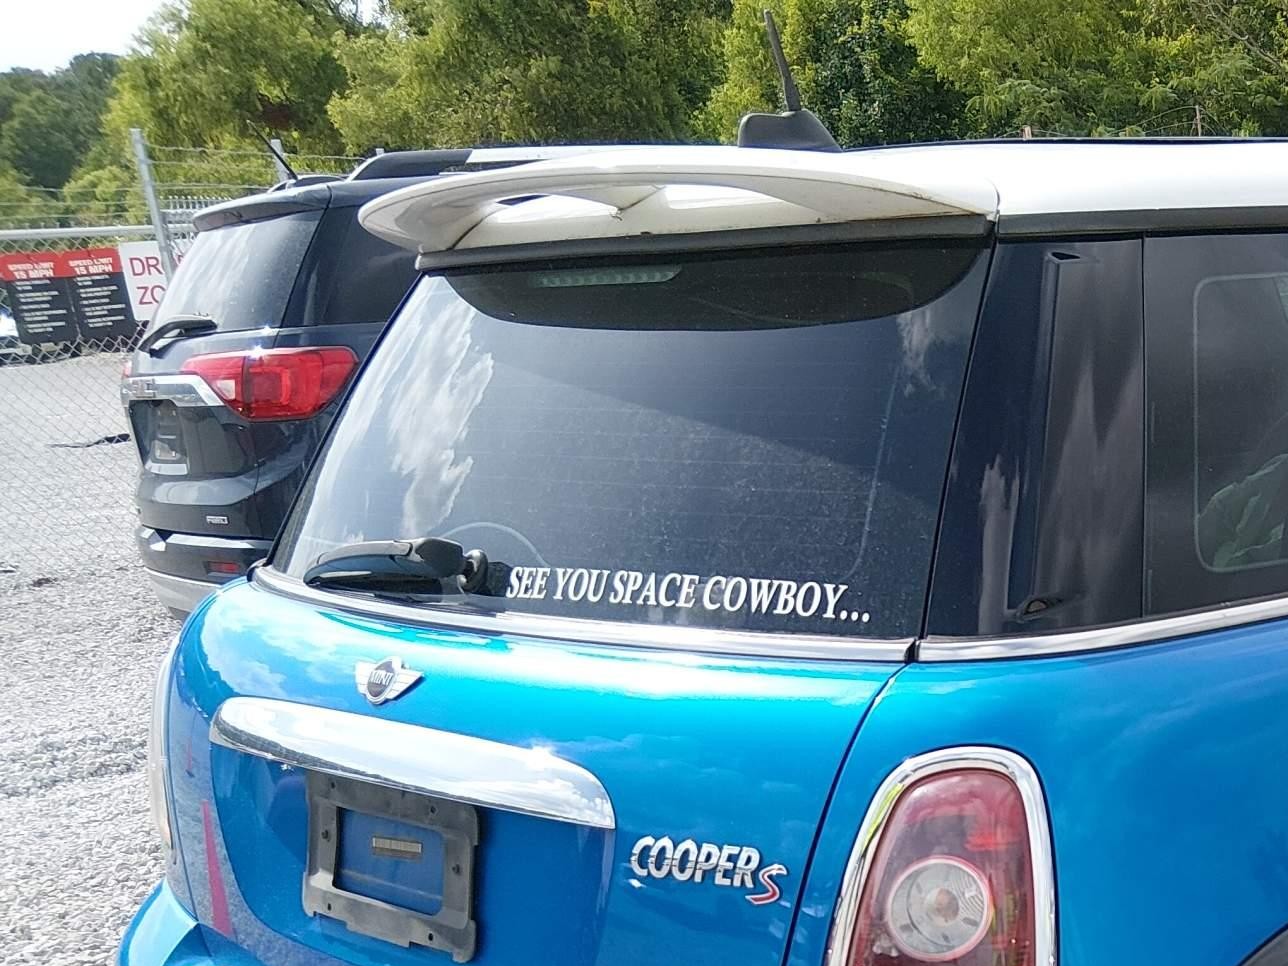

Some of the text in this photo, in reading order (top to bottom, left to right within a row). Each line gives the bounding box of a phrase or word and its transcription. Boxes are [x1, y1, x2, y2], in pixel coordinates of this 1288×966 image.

[13, 269, 54, 279] 15 MPH
[74, 264, 113, 275] 15 MPH
[506, 566, 870, 623] SEE YOU SPACE COWBOY...
[368, 669, 394, 686] MINI
[630, 836, 788, 905] COOPER S
